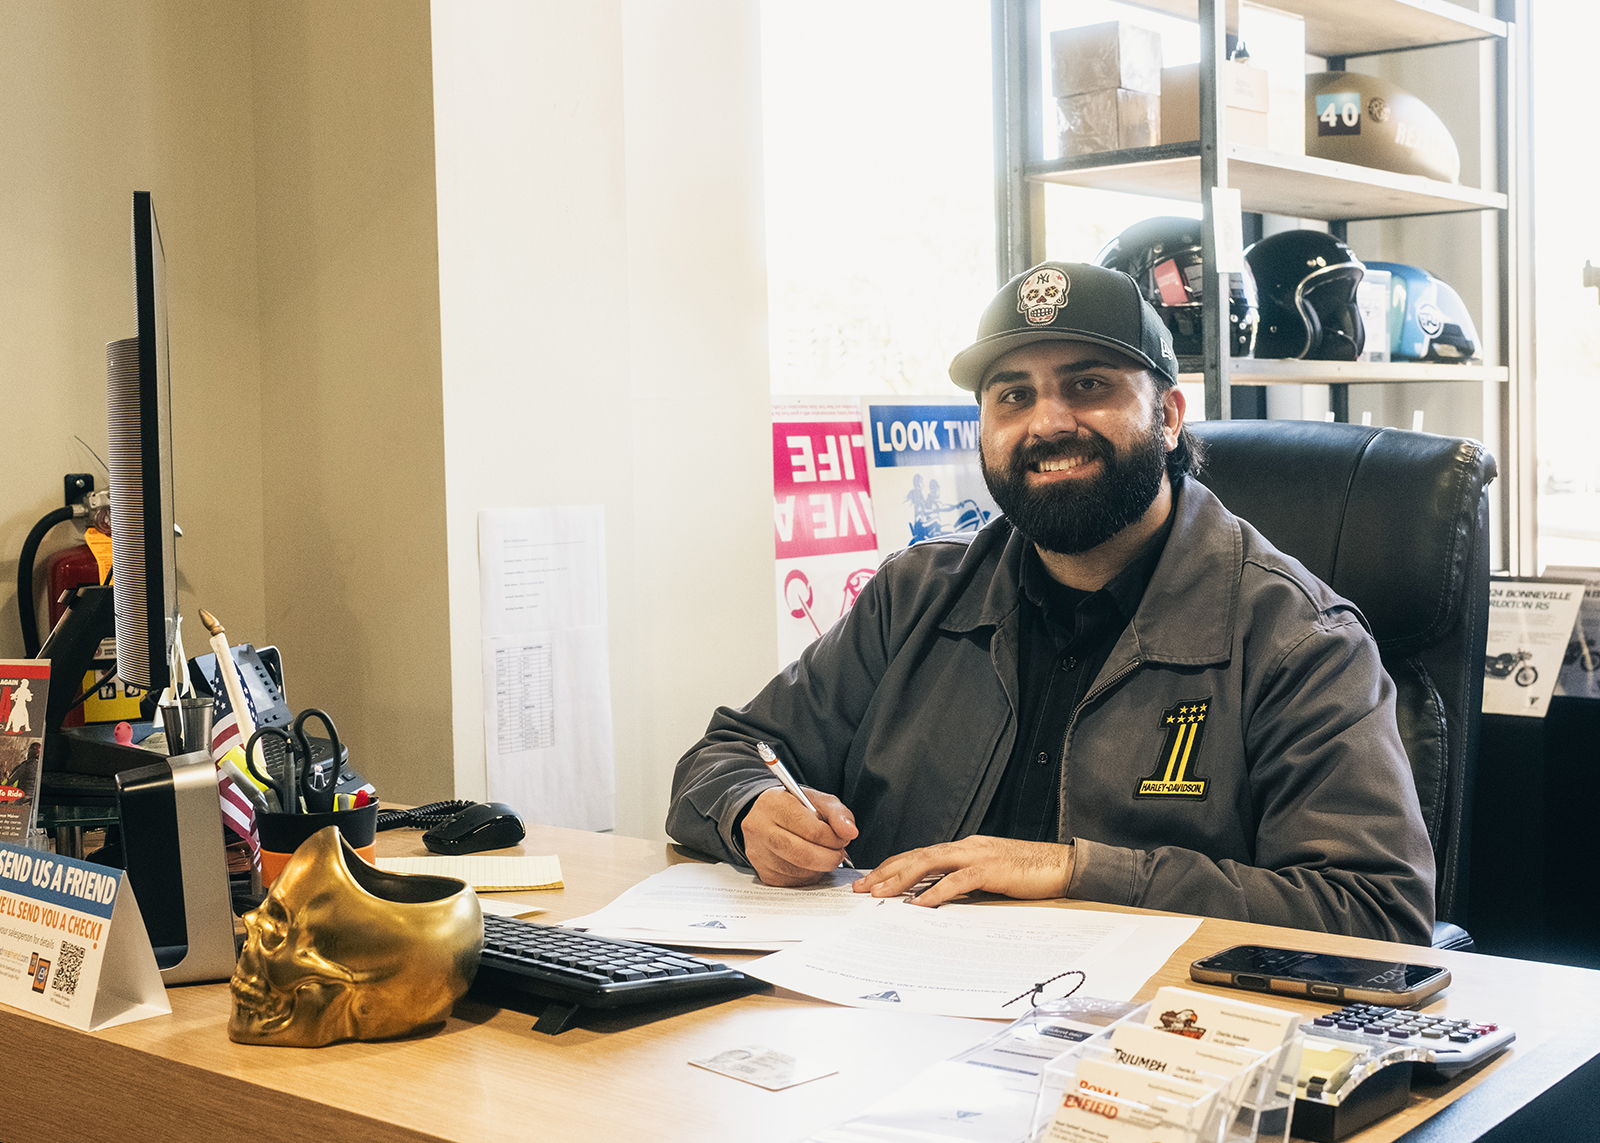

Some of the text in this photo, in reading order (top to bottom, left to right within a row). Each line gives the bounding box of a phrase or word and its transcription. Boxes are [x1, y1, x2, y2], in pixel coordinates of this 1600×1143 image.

[1320, 103, 1358, 127] 40
[876, 420, 941, 452] LOOK
[1490, 588, 1572, 600] 24 BONNEVILLE
[1490, 600, 1550, 610] RUXTON RS
[7, 789, 23, 797] Ride
[0, 849, 117, 905] SEND US A FRIEND
[0, 895, 103, 950] E'LL SEND YOU A CHECK!
[8, 928, 32, 942] salesperson
[40, 936, 54, 950] details
[1114, 1048, 1168, 1072] TRIUMPH
[1063, 1094, 1118, 1120] ENFIELD
